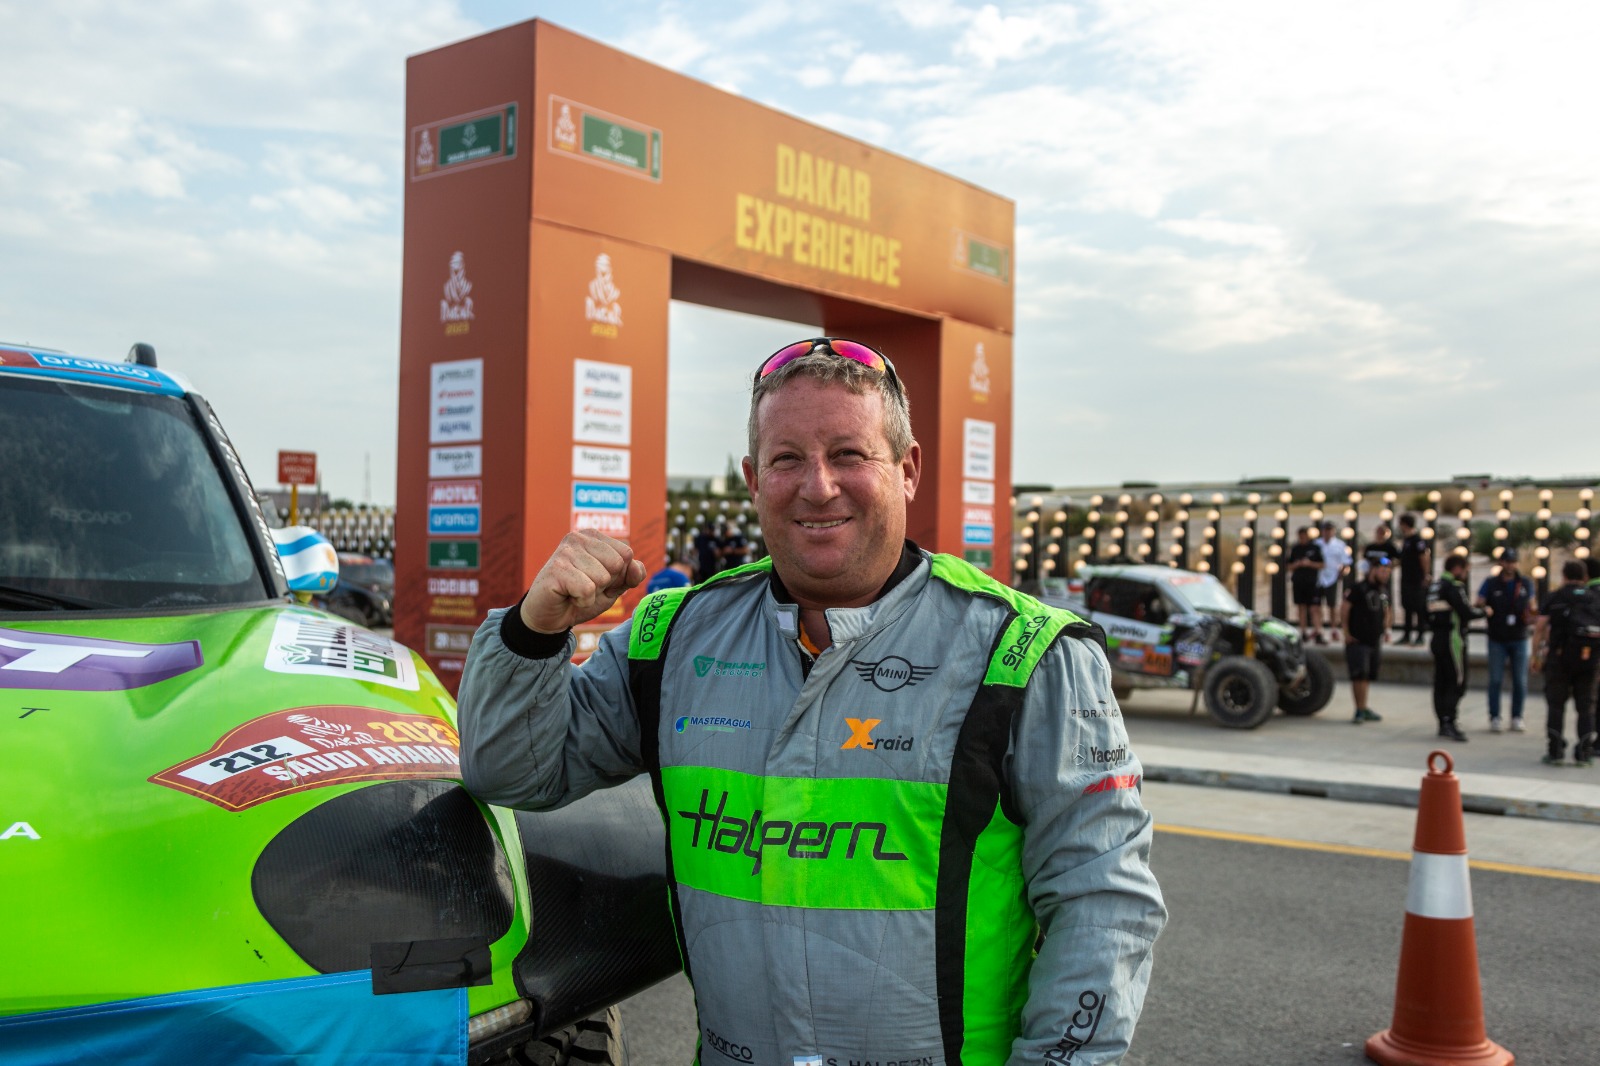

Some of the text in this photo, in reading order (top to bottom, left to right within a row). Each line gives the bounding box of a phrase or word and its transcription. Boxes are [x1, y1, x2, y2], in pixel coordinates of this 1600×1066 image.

[776, 142, 872, 222] DAKAR
[735, 192, 903, 288] EXPERIENCE
[42, 355, 150, 378] aramco
[433, 486, 477, 502] MOTUL
[576, 489, 626, 505] aramco
[433, 513, 477, 526] aramco
[576, 515, 625, 530] MOTUL
[641, 594, 668, 643] sparco
[1002, 615, 1047, 667] sparco
[877, 667, 908, 680] MINI
[367, 720, 460, 747] 2023
[690, 716, 752, 729] MASTERAGUA
[309, 731, 386, 749] DAKAR
[209, 743, 293, 774] 212
[262, 744, 460, 782] SAUDI ARABIA
[677, 788, 909, 877] Halpern
[706, 1028, 754, 1063] sparco
